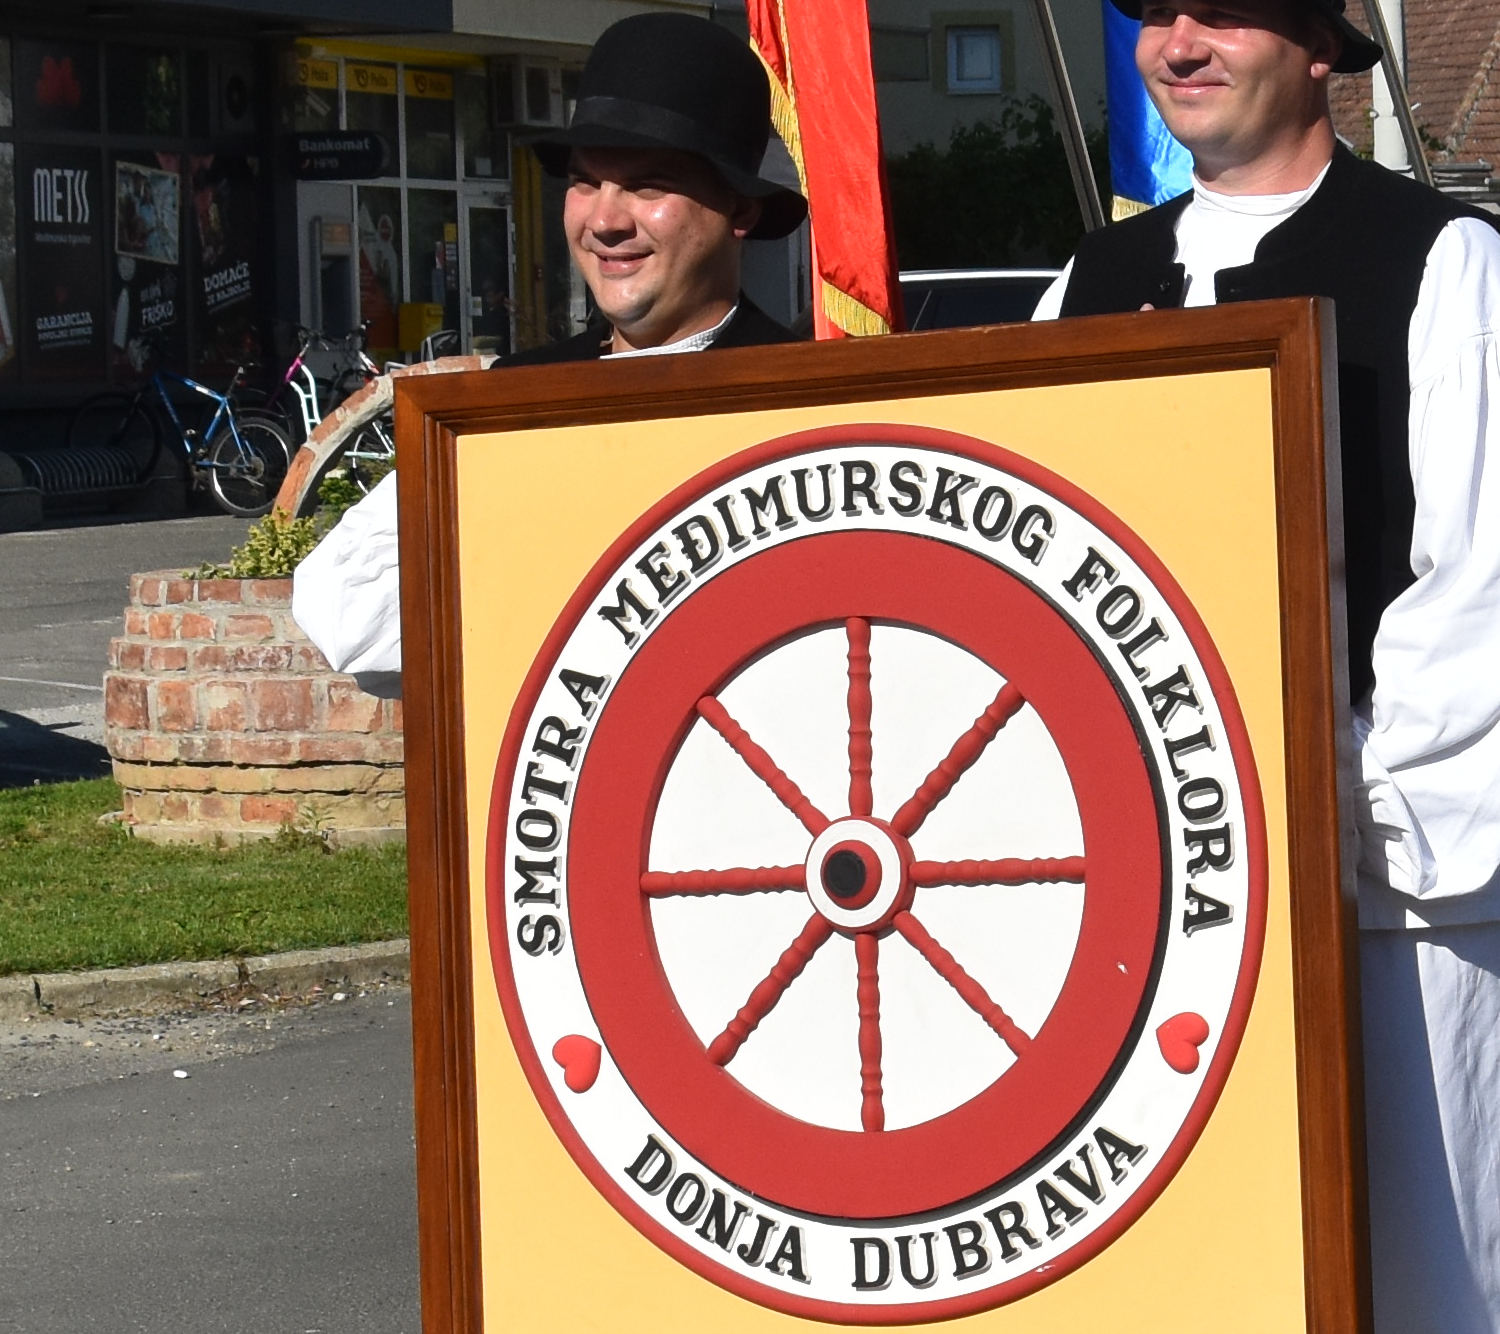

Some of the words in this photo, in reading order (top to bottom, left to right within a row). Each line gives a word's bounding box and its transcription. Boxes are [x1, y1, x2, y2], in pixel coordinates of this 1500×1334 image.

[299, 136, 371, 153] Bankomat
[36, 310, 94, 331] GARANCIJA
[514, 665, 612, 956] SMOTRA
[598, 457, 1056, 651] MEĐIMURSKOG
[1060, 545, 1236, 938] FOLKLORA
[623, 1133, 813, 1285] DONJA
[850, 1124, 1148, 1292] DUBRAVA
